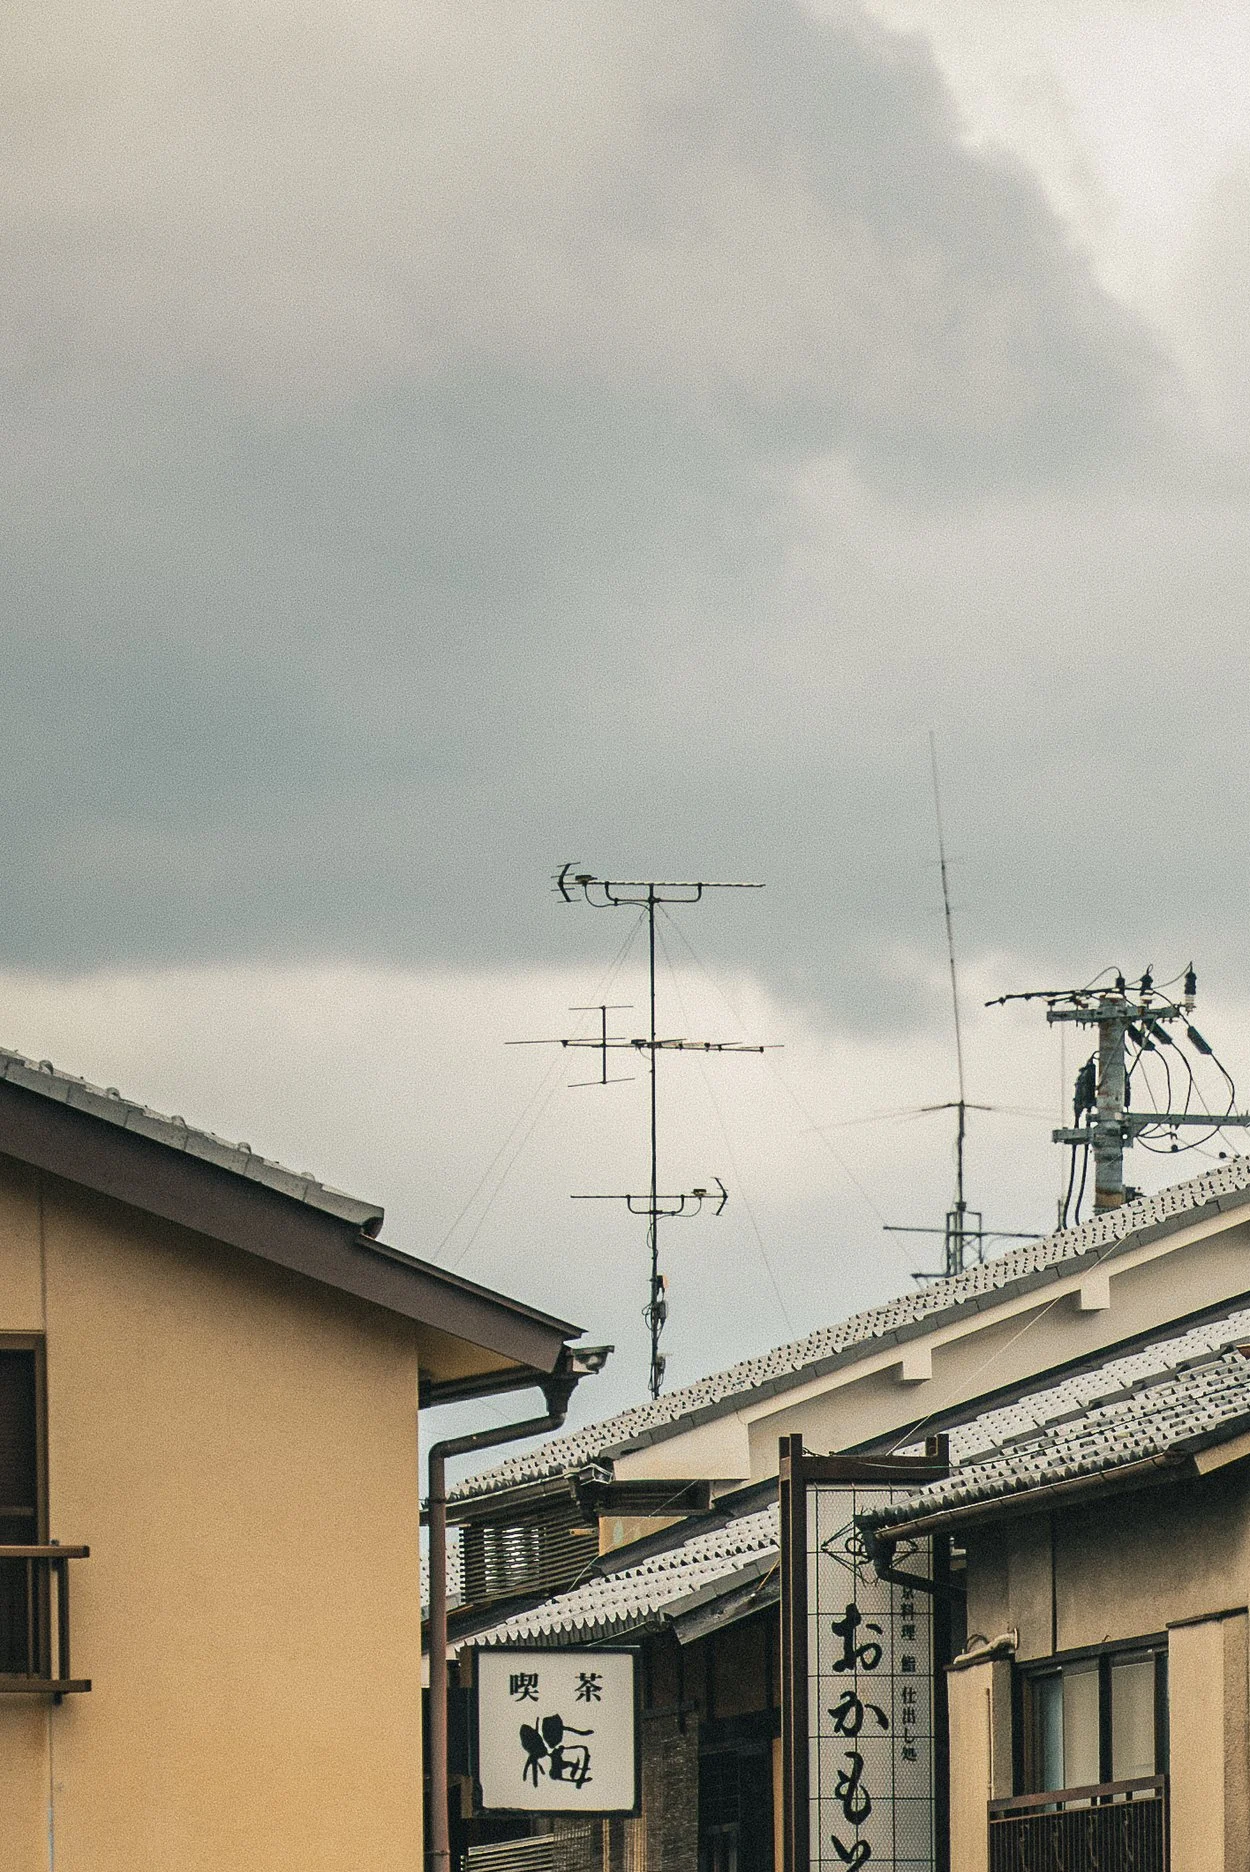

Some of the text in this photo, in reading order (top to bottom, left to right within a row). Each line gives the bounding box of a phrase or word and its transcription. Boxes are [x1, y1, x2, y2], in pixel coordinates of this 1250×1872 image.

[509, 1672, 604, 1703] 喫茶
[901, 1686, 918, 1763] 仕出し処
[519, 1713, 595, 1790] 梅
